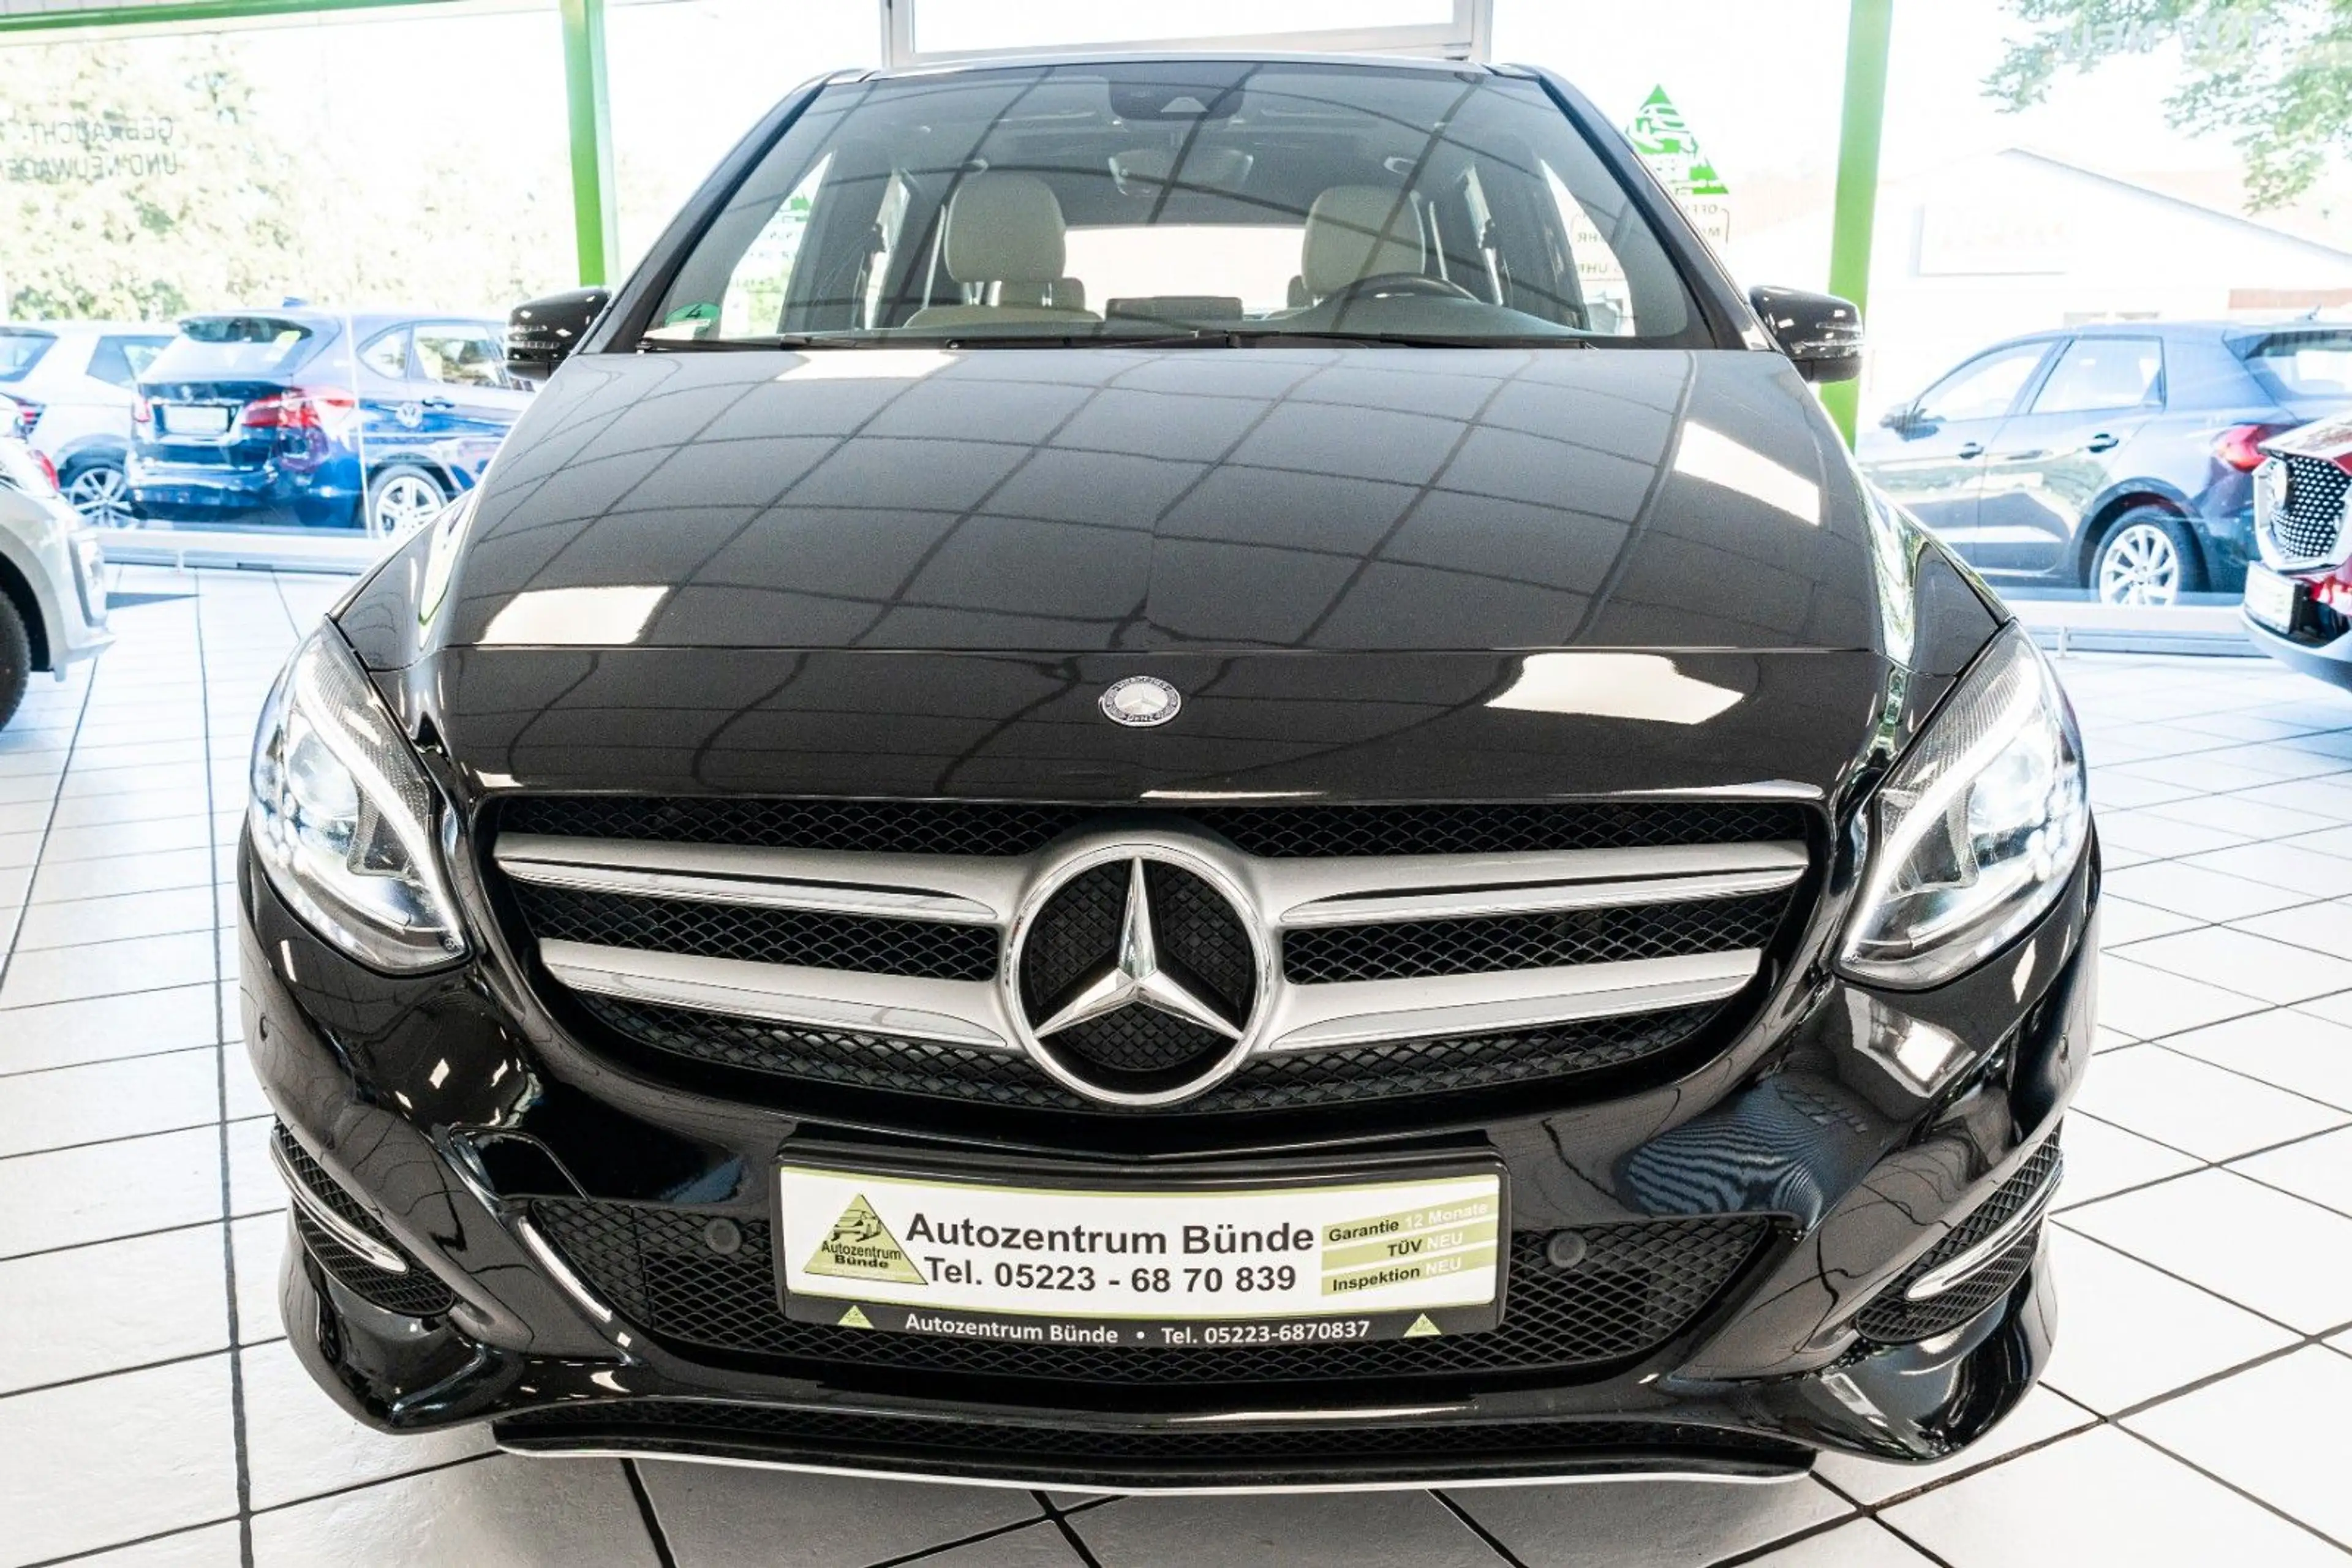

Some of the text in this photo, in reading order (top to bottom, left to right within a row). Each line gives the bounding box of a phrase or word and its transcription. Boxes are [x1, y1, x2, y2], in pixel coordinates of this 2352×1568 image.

[685, 304, 702, 319] 4
[906, 1213, 1314, 1254] Autozentrum Bünde
[1329, 1202, 1488, 1242] Garantie 12 Monate
[821, 1240, 902, 1260] Autozentrum
[1387, 1232, 1463, 1257] TÜV NEU
[835, 1254, 888, 1268] Bünde
[924, 1256, 982, 1285] Tel.
[995, 1263, 1095, 1291] 05223
[1131, 1268, 1170, 1292] 68
[1183, 1268, 1223, 1292] 70
[1236, 1265, 1295, 1292] 839
[1333, 1257, 1461, 1292] Inspektion NEU
[905, 1314, 1370, 1344] Autozentrum Bünde Tel. 05223-6870837
